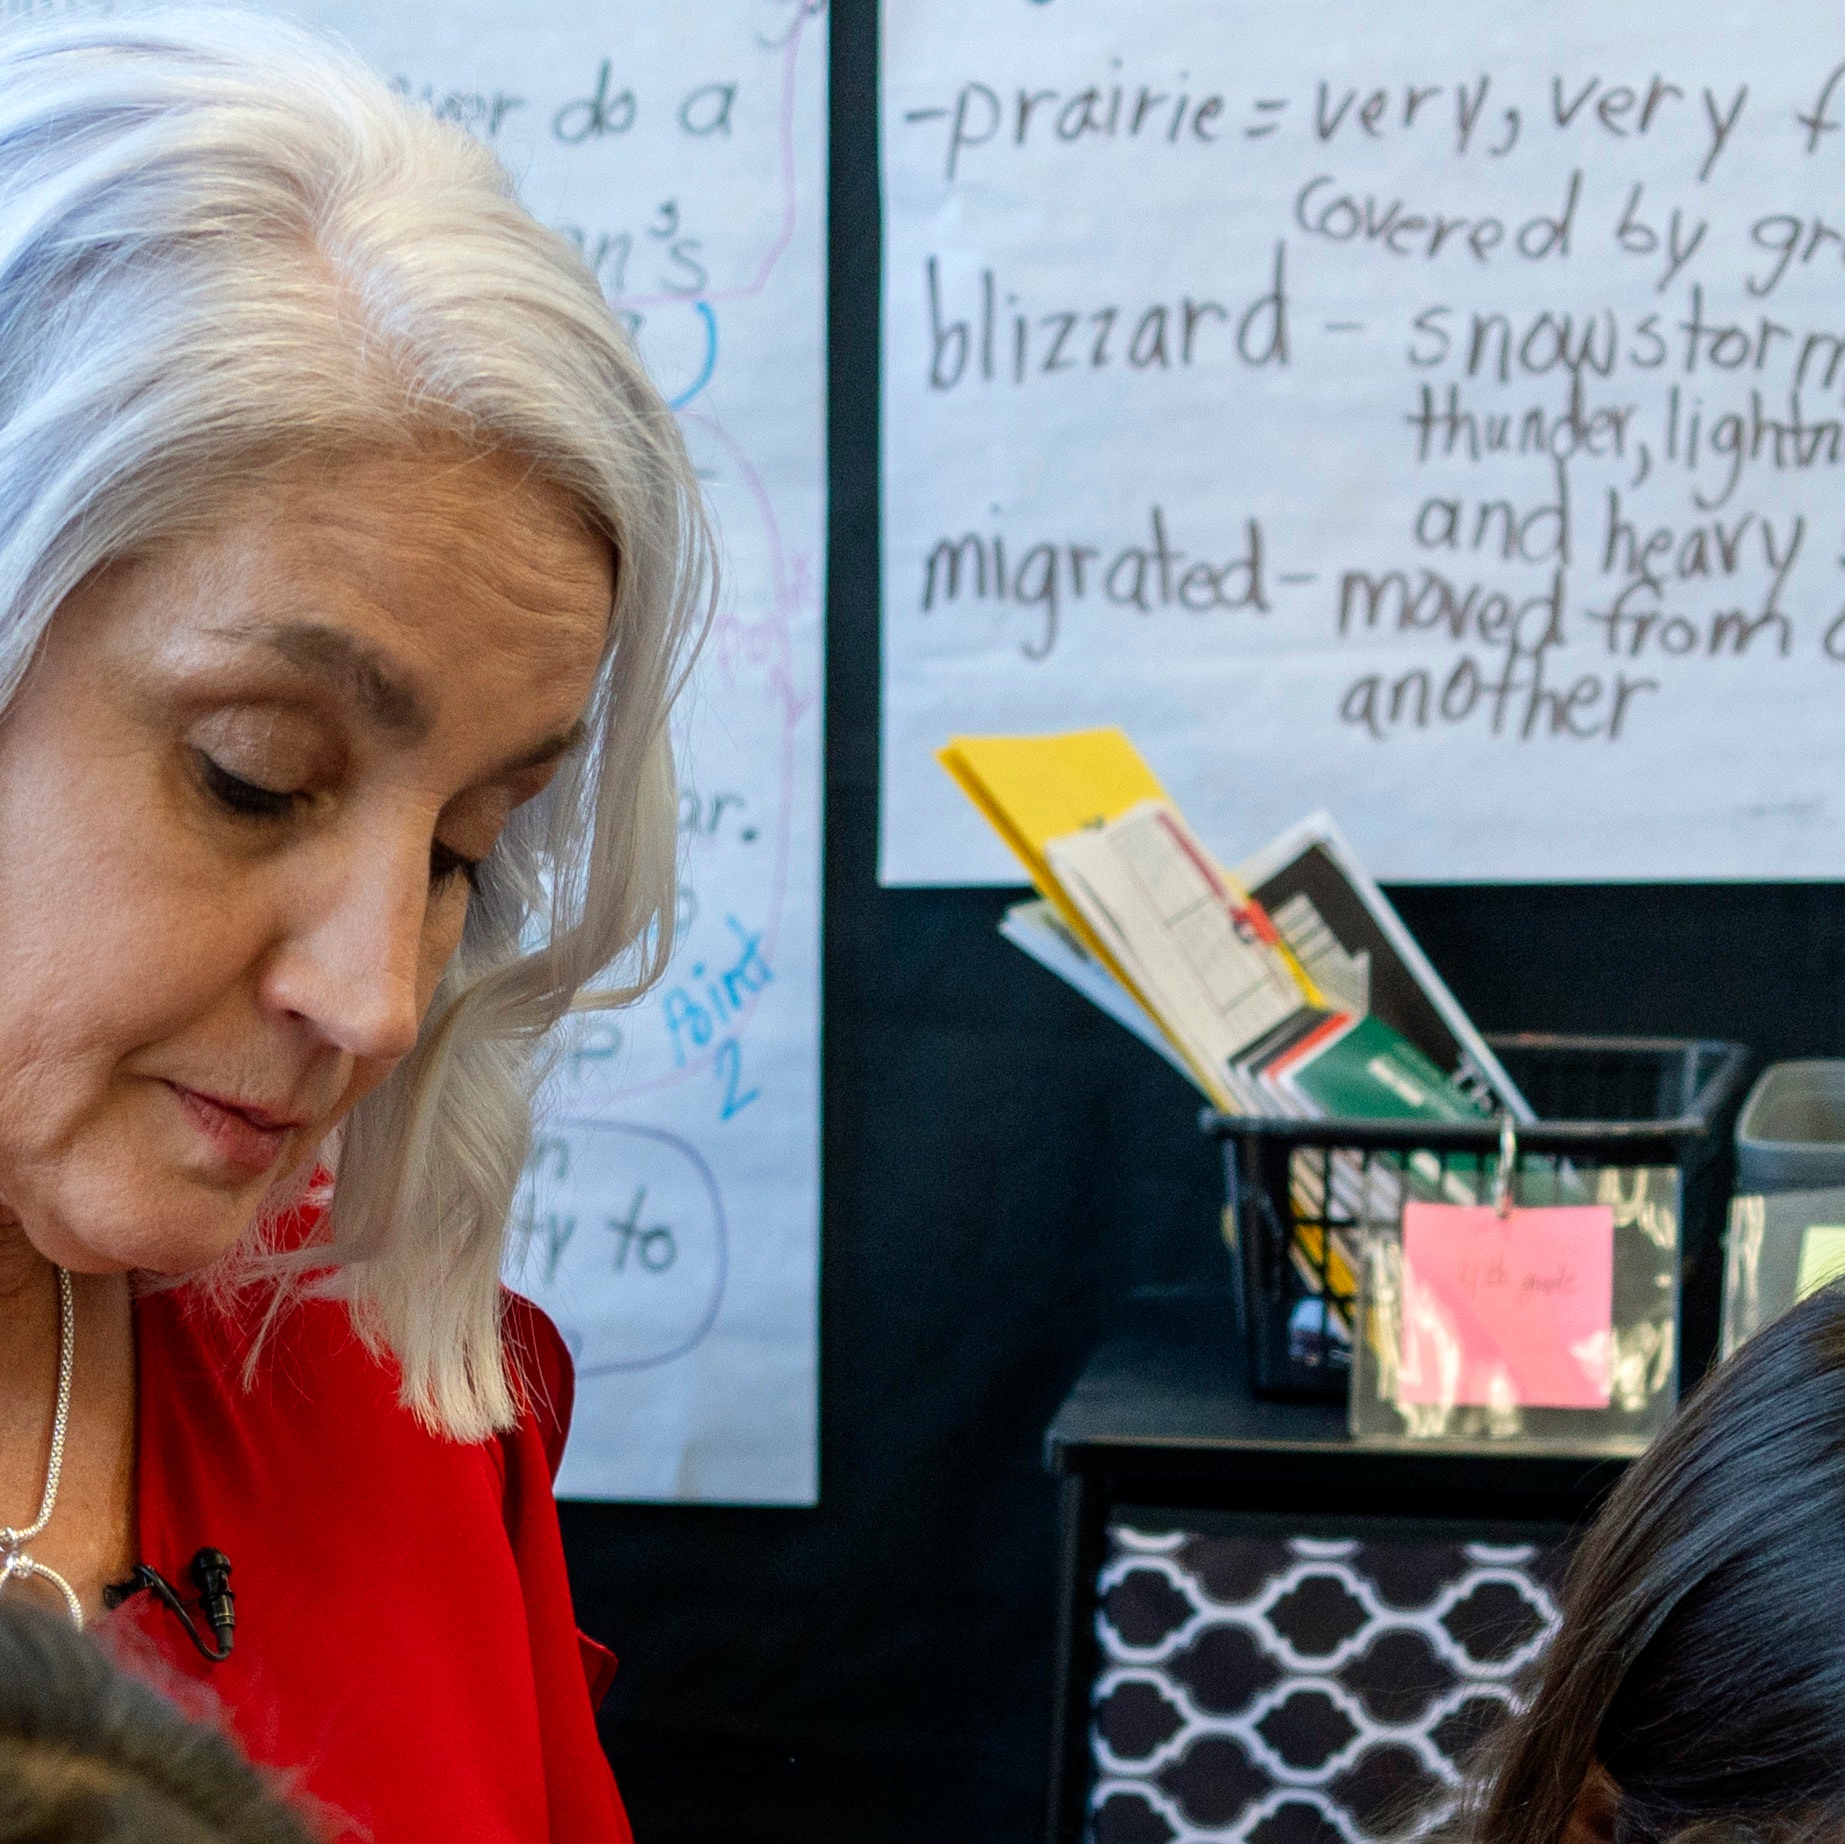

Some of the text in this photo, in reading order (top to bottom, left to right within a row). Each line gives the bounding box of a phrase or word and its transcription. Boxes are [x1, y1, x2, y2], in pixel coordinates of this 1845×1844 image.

[554, 57, 637, 144] do
[680, 78, 739, 139] a
[1552, 72, 1748, 182] very
[1617, 182, 1708, 293] by
[926, 240, 1291, 390] blizzard
[1415, 458, 1571, 566] and
[1602, 487, 1805, 610] heavy
[1338, 566, 1566, 656] moved
[1585, 577, 1794, 657] from
[1340, 640, 1661, 742] another
[714, 1037, 761, 1122] 2
[607, 1182, 679, 1273] to
